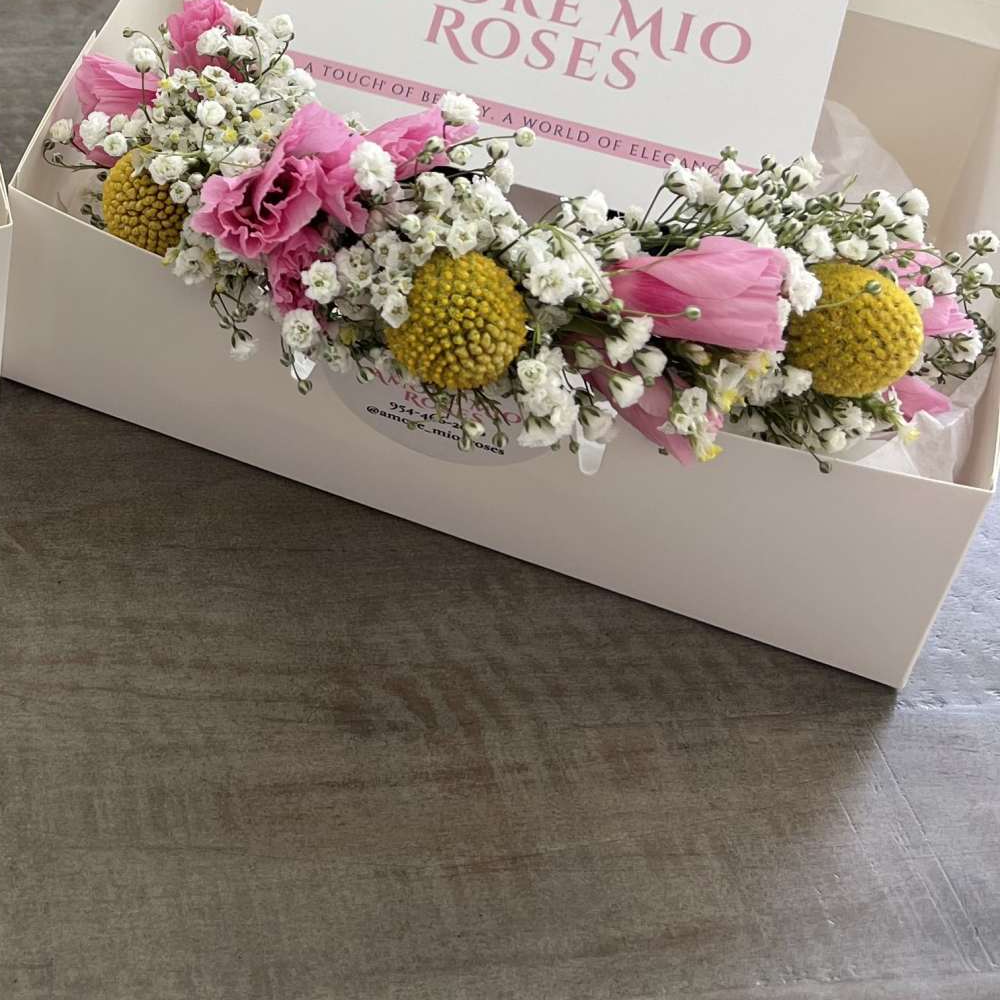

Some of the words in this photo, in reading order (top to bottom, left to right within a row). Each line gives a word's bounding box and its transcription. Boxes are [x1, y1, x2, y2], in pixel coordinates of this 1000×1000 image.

[423, 3, 641, 92] ROSES
[303, 61, 314, 74] A
[322, 63, 387, 92] TOUCH
[391, 82, 415, 99] OF
[421, 90, 495, 121] BEY,
[502, 112, 514, 125] A
[522, 115, 590, 144] WORLD
[597, 135, 623, 152] OF
